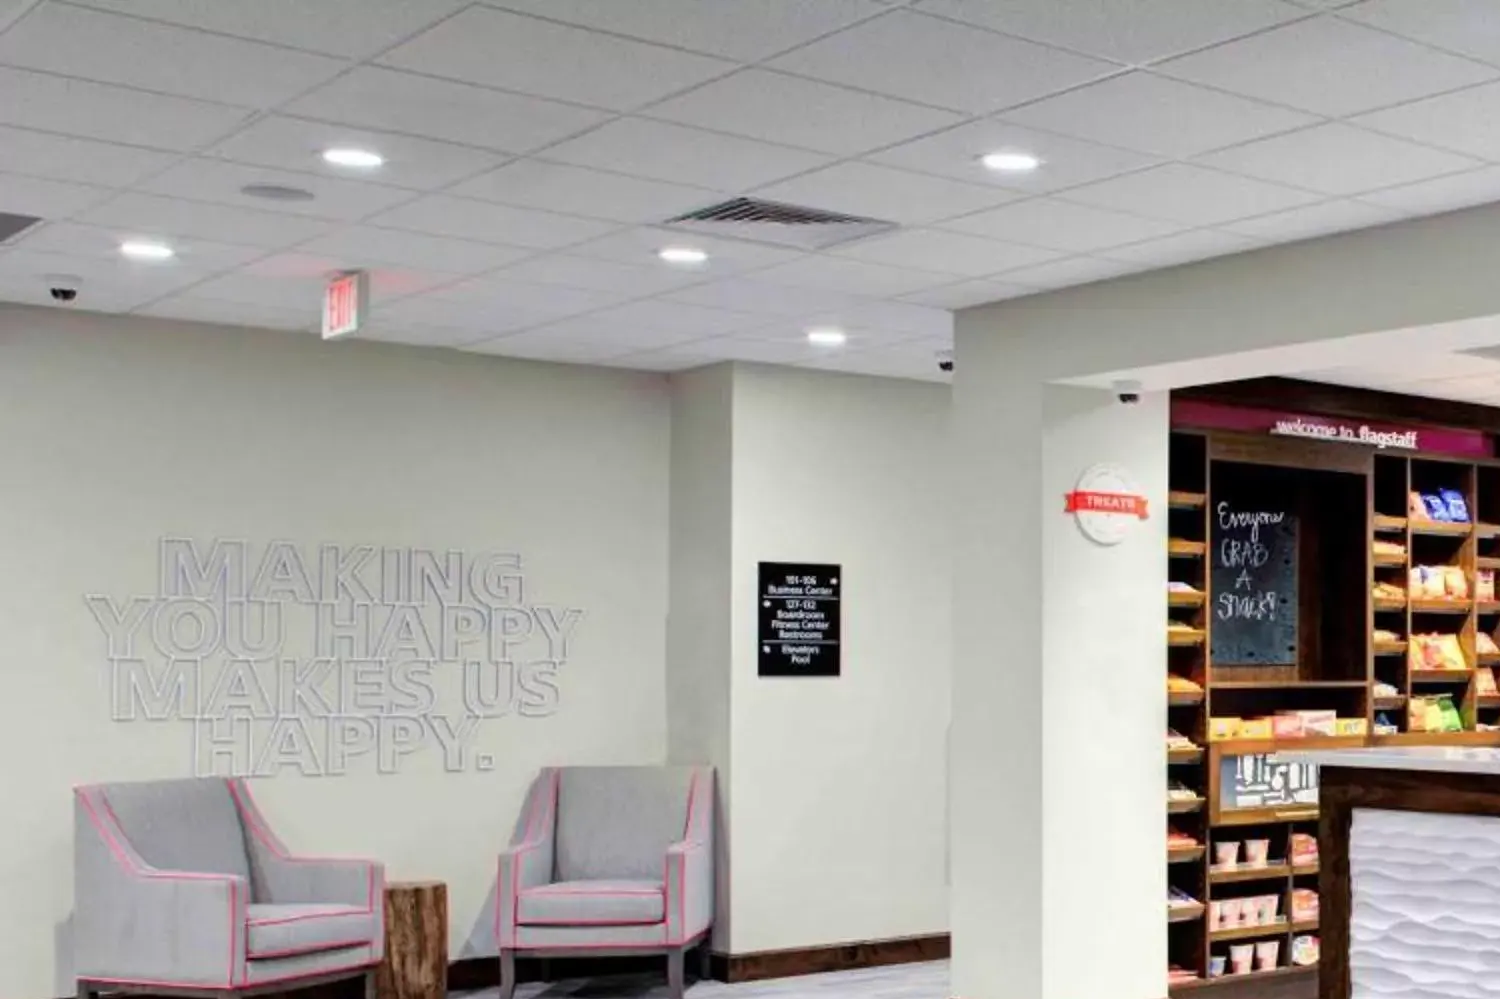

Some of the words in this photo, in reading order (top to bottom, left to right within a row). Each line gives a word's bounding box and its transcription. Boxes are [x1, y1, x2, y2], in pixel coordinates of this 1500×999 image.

[1275, 419, 1337, 437] welcome
[1339, 425, 1353, 438] to
[1359, 425, 1418, 448] flagstaff
[1086, 495, 1136, 510] TREATS
[1221, 538, 1269, 568] GRAB
[158, 535, 526, 606] MAKING
[1235, 567, 1252, 591] A
[768, 585, 803, 595] Business
[805, 586, 833, 595] Center
[85, 594, 286, 662] YOU
[313, 600, 585, 664] HAPPY
[802, 621, 830, 630] Center
[107, 656, 438, 721] MAKES
[461, 660, 562, 718] US
[187, 713, 497, 779] HAPPY.
